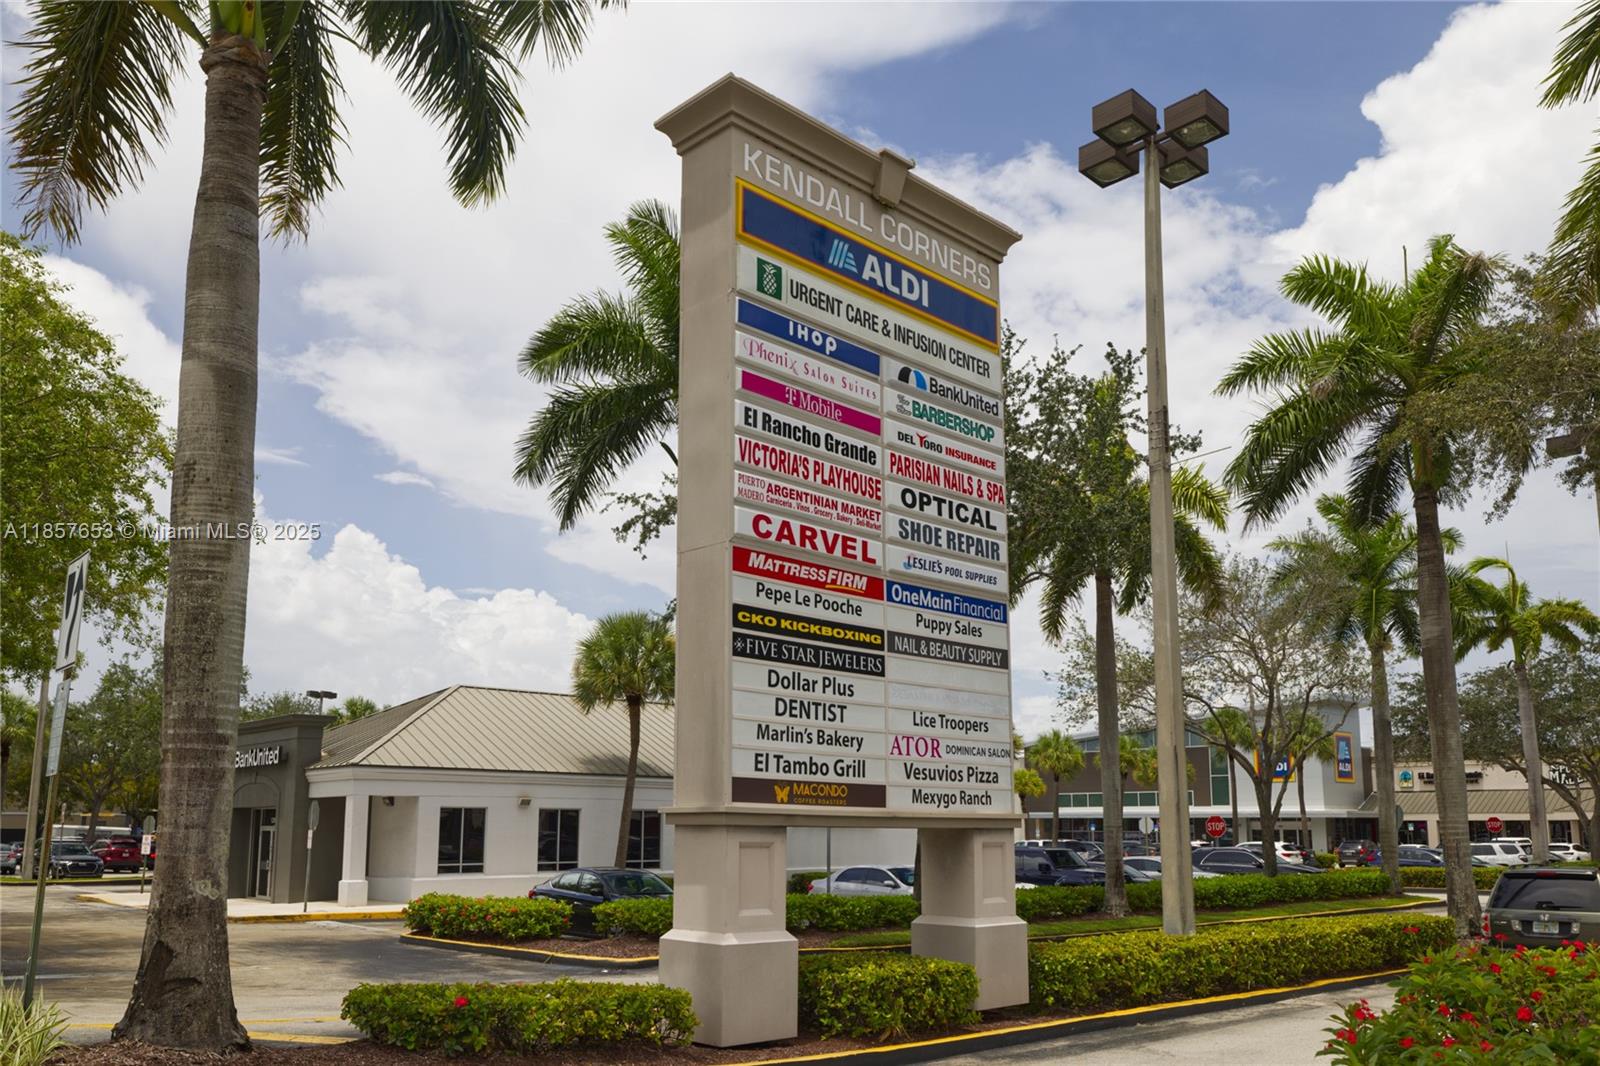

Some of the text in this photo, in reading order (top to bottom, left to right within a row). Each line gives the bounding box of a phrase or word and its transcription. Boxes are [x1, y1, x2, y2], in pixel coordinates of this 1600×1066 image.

[743, 143, 992, 290] KENDALL CORNERS
[861, 253, 929, 308] ALDI
[788, 320, 837, 355] IHOP
[790, 278, 991, 378] URGENT CARE & INFUSION CENTER
[743, 335, 799, 375] Phenix
[929, 377, 999, 416] BankUnited
[743, 406, 877, 466] El Rancho Grande
[912, 400, 995, 442] BARBERSHOP
[897, 431, 916, 445] DEL
[945, 447, 997, 471] INSURANCE
[738, 437, 882, 501] VICTORIA'S PLAYHOUSE
[738, 473, 766, 489] PUERTO
[889, 452, 1005, 505] PARISIAN NAILS & SPA
[737, 486, 765, 502] MADERO
[766, 482, 881, 522] ARGENTINIAN MARKET
[900, 487, 998, 531] OPTICAL
[752, 513, 877, 565] CARVEL
[898, 518, 1000, 561] SHOE REPAIR
[906, 555, 998, 586] LESLIE'S POOL SUPPLIES
[756, 582, 863, 617] Pepe Le Pooche
[737, 610, 882, 645] CKO KICKBOXING
[916, 613, 983, 638] Puppy Sales
[746, 638, 883, 673] FIVE STAR JEWELERS
[894, 635, 1003, 667] NAIL & BEAUTY SUPPLY
[767, 669, 855, 698] Dollar Plus
[774, 697, 847, 723] DENTIST
[913, 711, 989, 735] Lice Troopers
[235, 745, 280, 768] BankUnited
[816, 729, 864, 753] Bakery
[890, 735, 1011, 758] ATOR DOMINICAN SALON
[754, 753, 866, 779] El Tambo Grill
[903, 762, 999, 784] Vesuvios Pizza
[1339, 762, 1352, 771] ALDI
[793, 783, 849, 797] MACONDO
[911, 788, 992, 809] Mexygo Ranch
[1207, 822, 1225, 831] STOP
[1487, 821, 1502, 829] STOP
